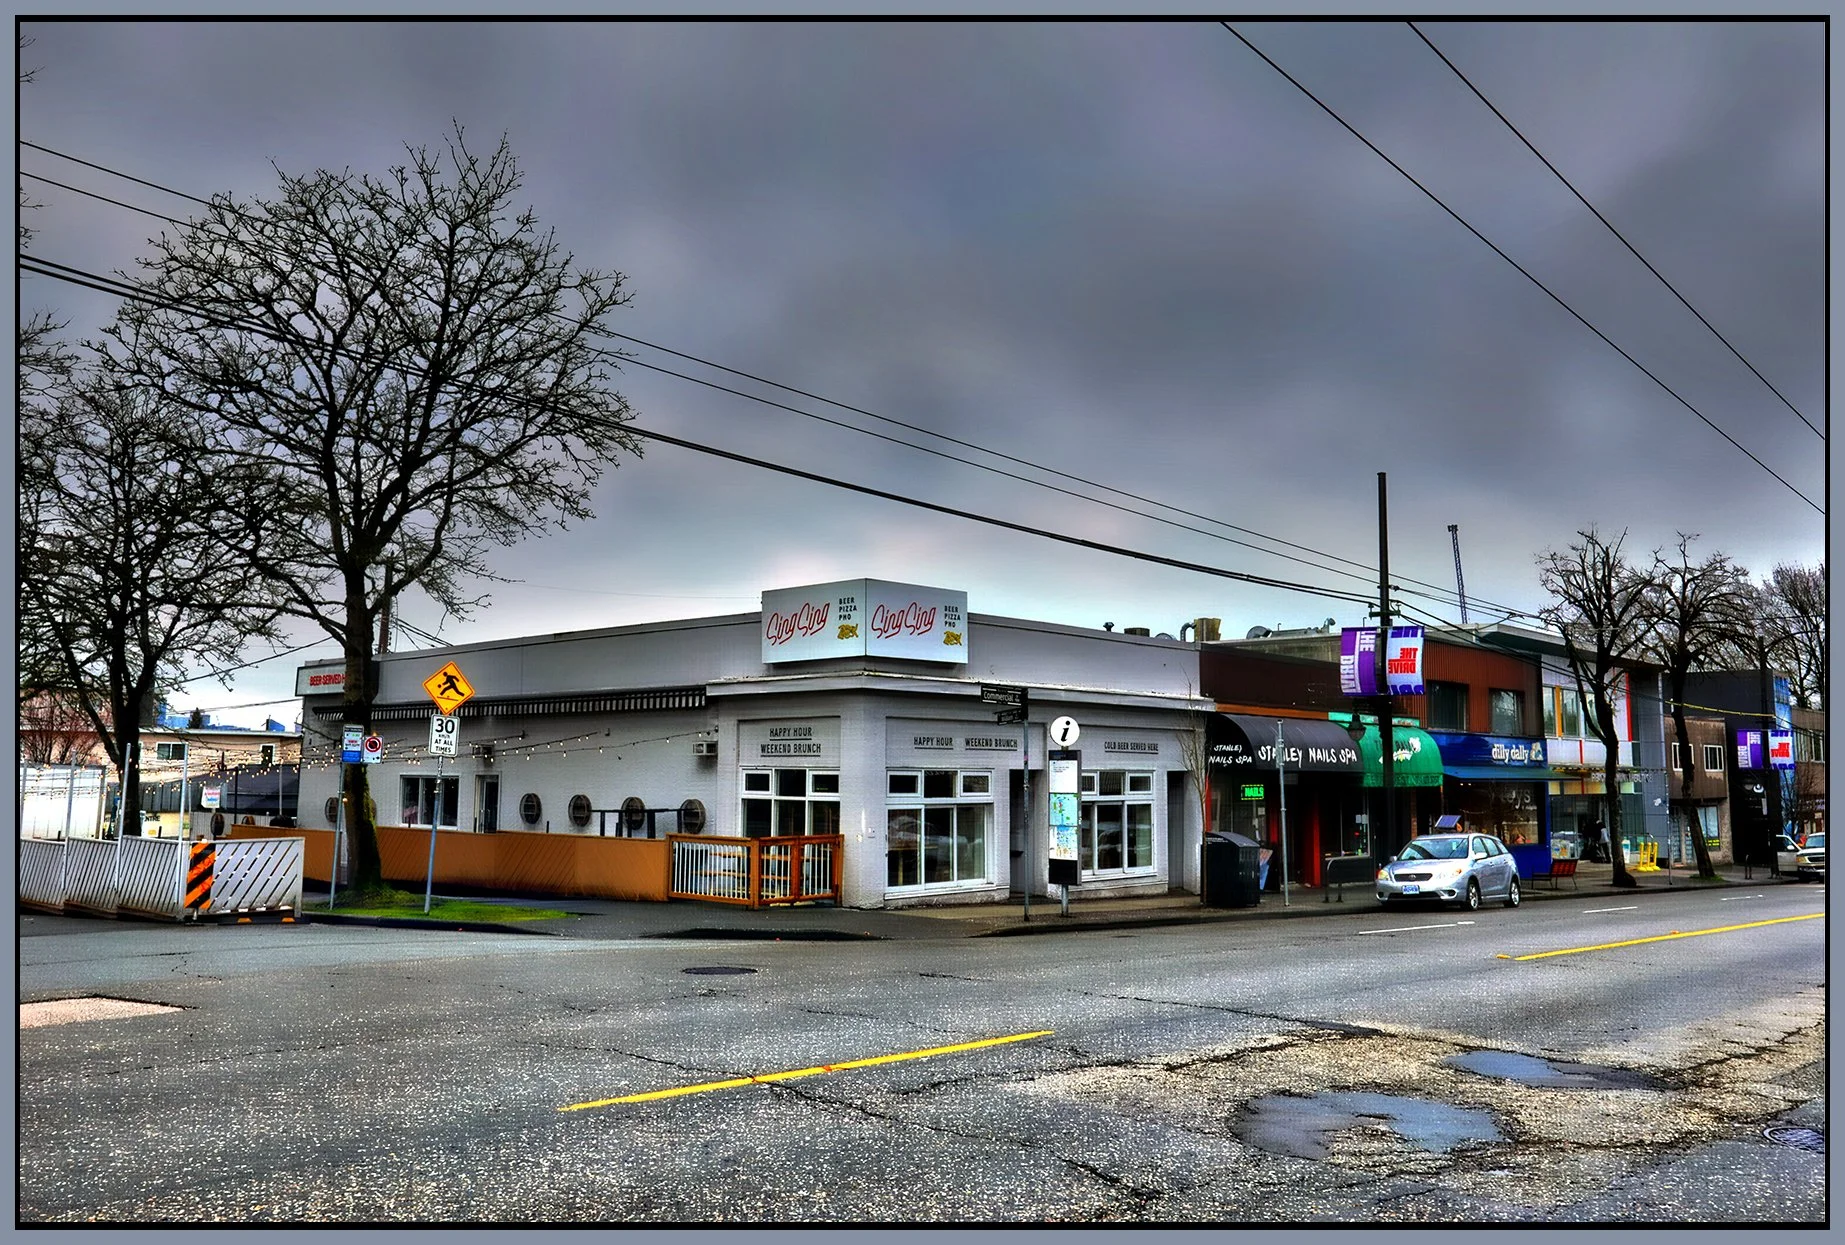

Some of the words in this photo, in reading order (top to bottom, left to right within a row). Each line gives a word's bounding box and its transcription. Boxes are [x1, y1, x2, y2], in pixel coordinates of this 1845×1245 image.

[871, 604, 904, 639] Sing
[904, 602, 936, 636] Sing
[944, 613, 961, 621] PIZZA
[766, 612, 798, 646] Sing
[797, 602, 830, 637] Sing
[309, 675, 322, 686] BEER
[322, 673, 342, 685] SERVED
[435, 718, 456, 734] 30
[769, 728, 791, 737] HAPPY
[793, 727, 812, 737] HOUR
[914, 736, 934, 746] HAPPY
[936, 737, 954, 746] HOUR
[965, 738, 992, 747] WEEKEND
[994, 738, 1018, 748] BRUNCH
[1104, 741, 1116, 750] COLD
[1117, 742, 1129, 750] BEER
[1130, 742, 1146, 751] SERVED
[1147, 743, 1159, 752] HERE
[760, 744, 791, 753] WEEKEND
[793, 743, 821, 753] BRUNCH
[1213, 744, 1243, 753] STANLEY
[1208, 756, 1233, 764] NAILS
[1235, 755, 1252, 764] SPA
[1308, 747, 1337, 763] NAILS
[1339, 748, 1357, 765] SPA
[1492, 744, 1509, 764] dilly
[1510, 744, 1529, 764] dally
[1244, 786, 1265, 797] NAILS
